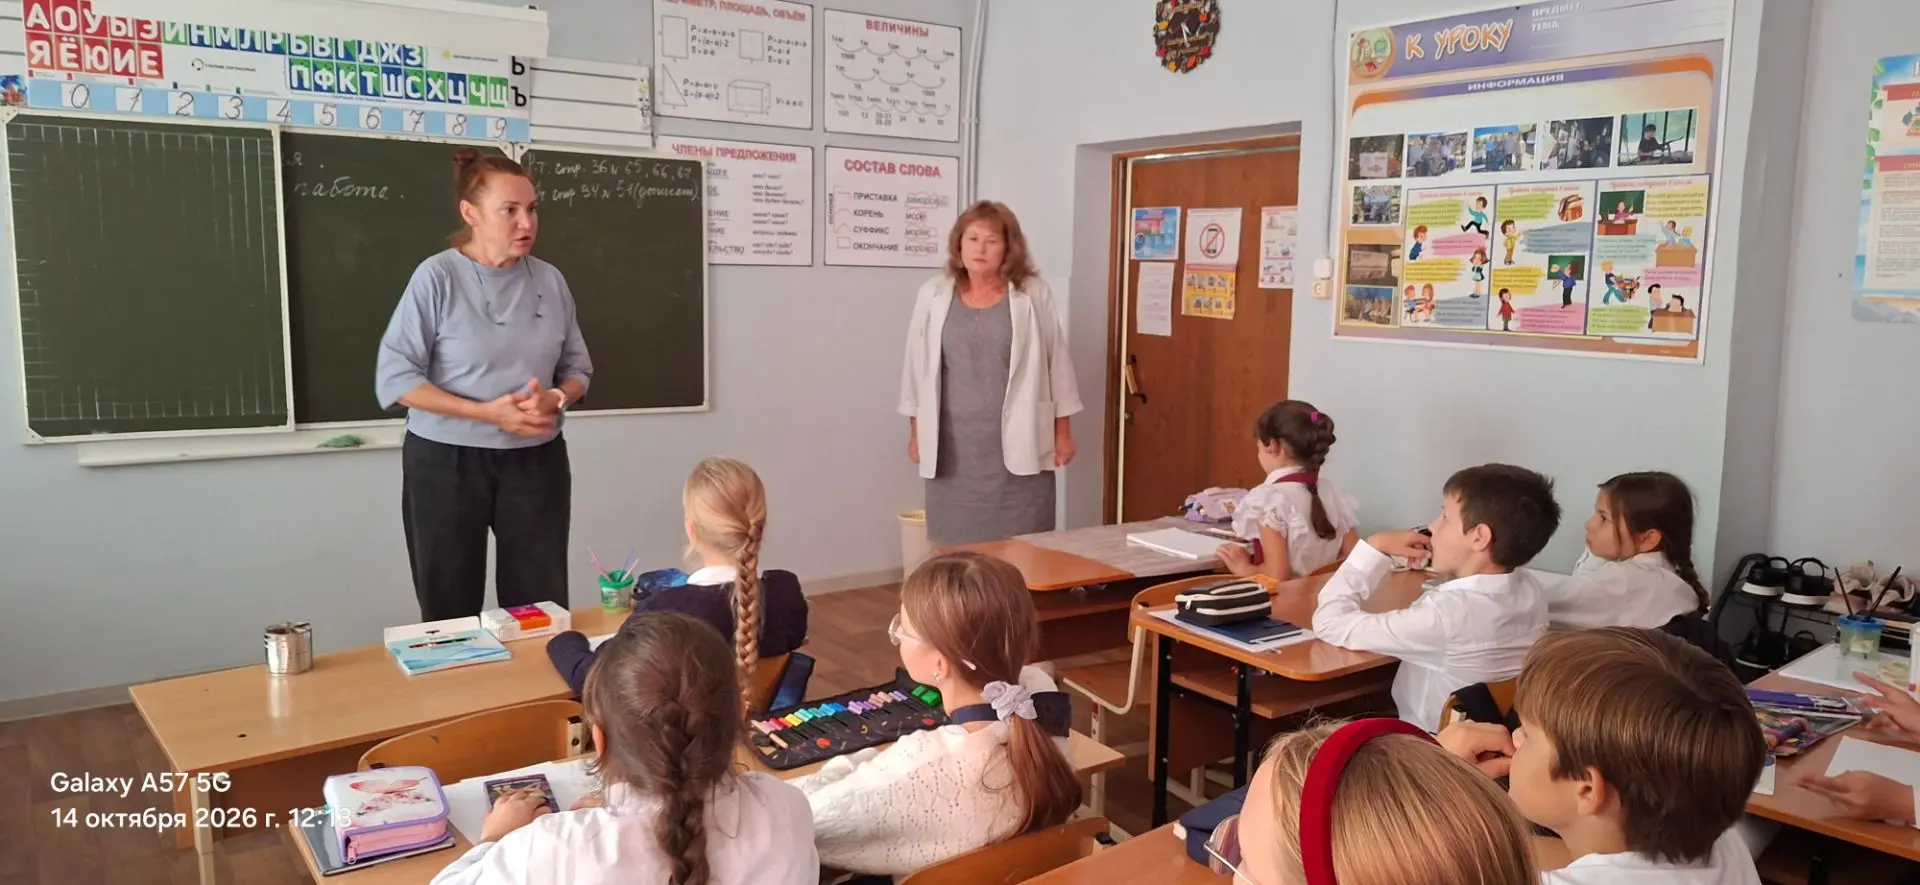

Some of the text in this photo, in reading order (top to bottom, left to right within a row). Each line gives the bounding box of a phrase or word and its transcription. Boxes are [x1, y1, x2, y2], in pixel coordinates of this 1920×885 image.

[866, 19, 928, 37] ВЕЛИЧИНЫ
[1405, 19, 1513, 60] К УРОКУ
[1468, 74, 1564, 91] ИНФОРМАЦИЯ
[175, 91, 194, 116] 2
[225, 96, 243, 120] 3
[320, 103, 336, 126] 5
[366, 107, 382, 130] 6
[409, 110, 424, 132] 7
[452, 114, 466, 136] 8
[493, 117, 507, 138] 9
[672, 143, 797, 163] ЧЛЕНЫ ПРЕДЛОЖЕНИЯ
[844, 158, 941, 178] СОСТАВ СЛОВА
[853, 192, 898, 202] ПРИСТАВКА
[853, 209, 884, 218] КОРЕНЬ
[853, 225, 890, 235] СУФФИКС
[853, 242, 899, 252] ОКОНЧАНИЕ
